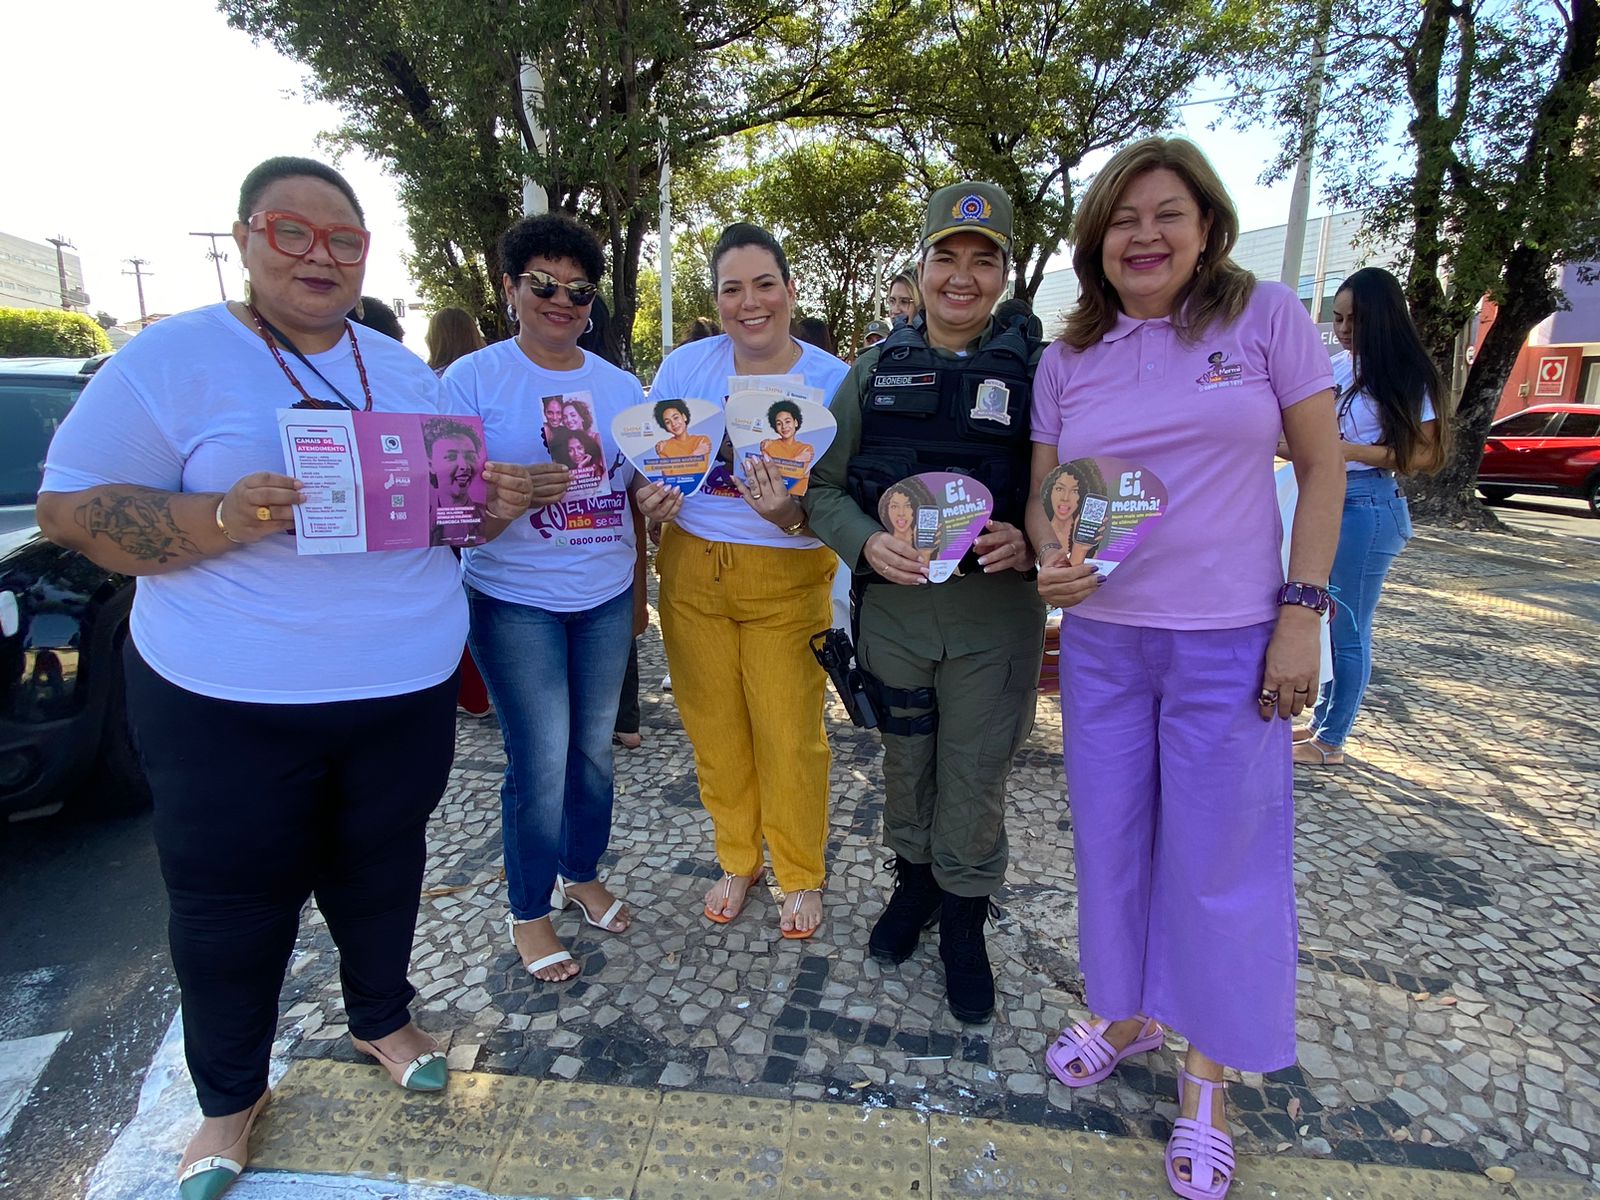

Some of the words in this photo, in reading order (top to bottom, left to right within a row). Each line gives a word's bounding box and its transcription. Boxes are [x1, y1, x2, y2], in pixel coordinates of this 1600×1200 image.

[877, 376, 913, 385] LEONEIDE
[578, 476, 601, 484] MEDIDAS
[1119, 470, 1146, 500] Ei,
[945, 478, 970, 504] Ei,
[568, 515, 592, 528] não
[596, 518, 608, 527] se
[570, 537, 594, 546] 0800
[595, 535, 613, 543] 000
